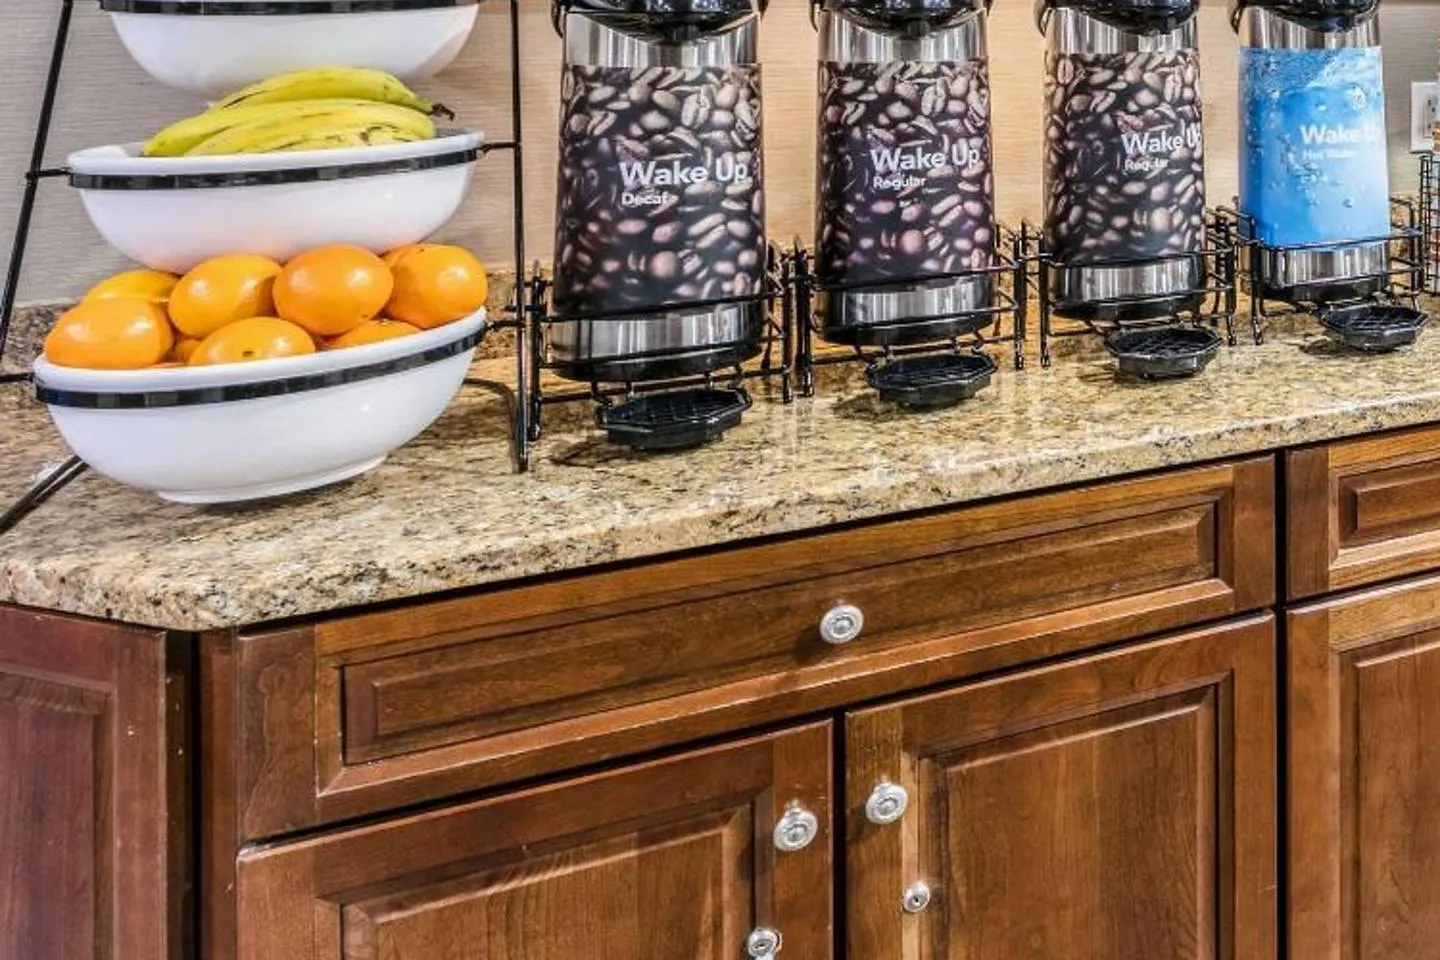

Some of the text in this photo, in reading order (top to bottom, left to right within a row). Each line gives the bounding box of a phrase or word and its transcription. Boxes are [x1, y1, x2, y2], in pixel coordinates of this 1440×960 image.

[1121, 130, 1184, 155] Wake
[1300, 124, 1360, 145] Wake
[869, 138, 981, 173] Wake Up
[619, 152, 748, 186] Wake Up
[872, 175, 927, 190] Regular
[621, 191, 670, 206] Decaf
